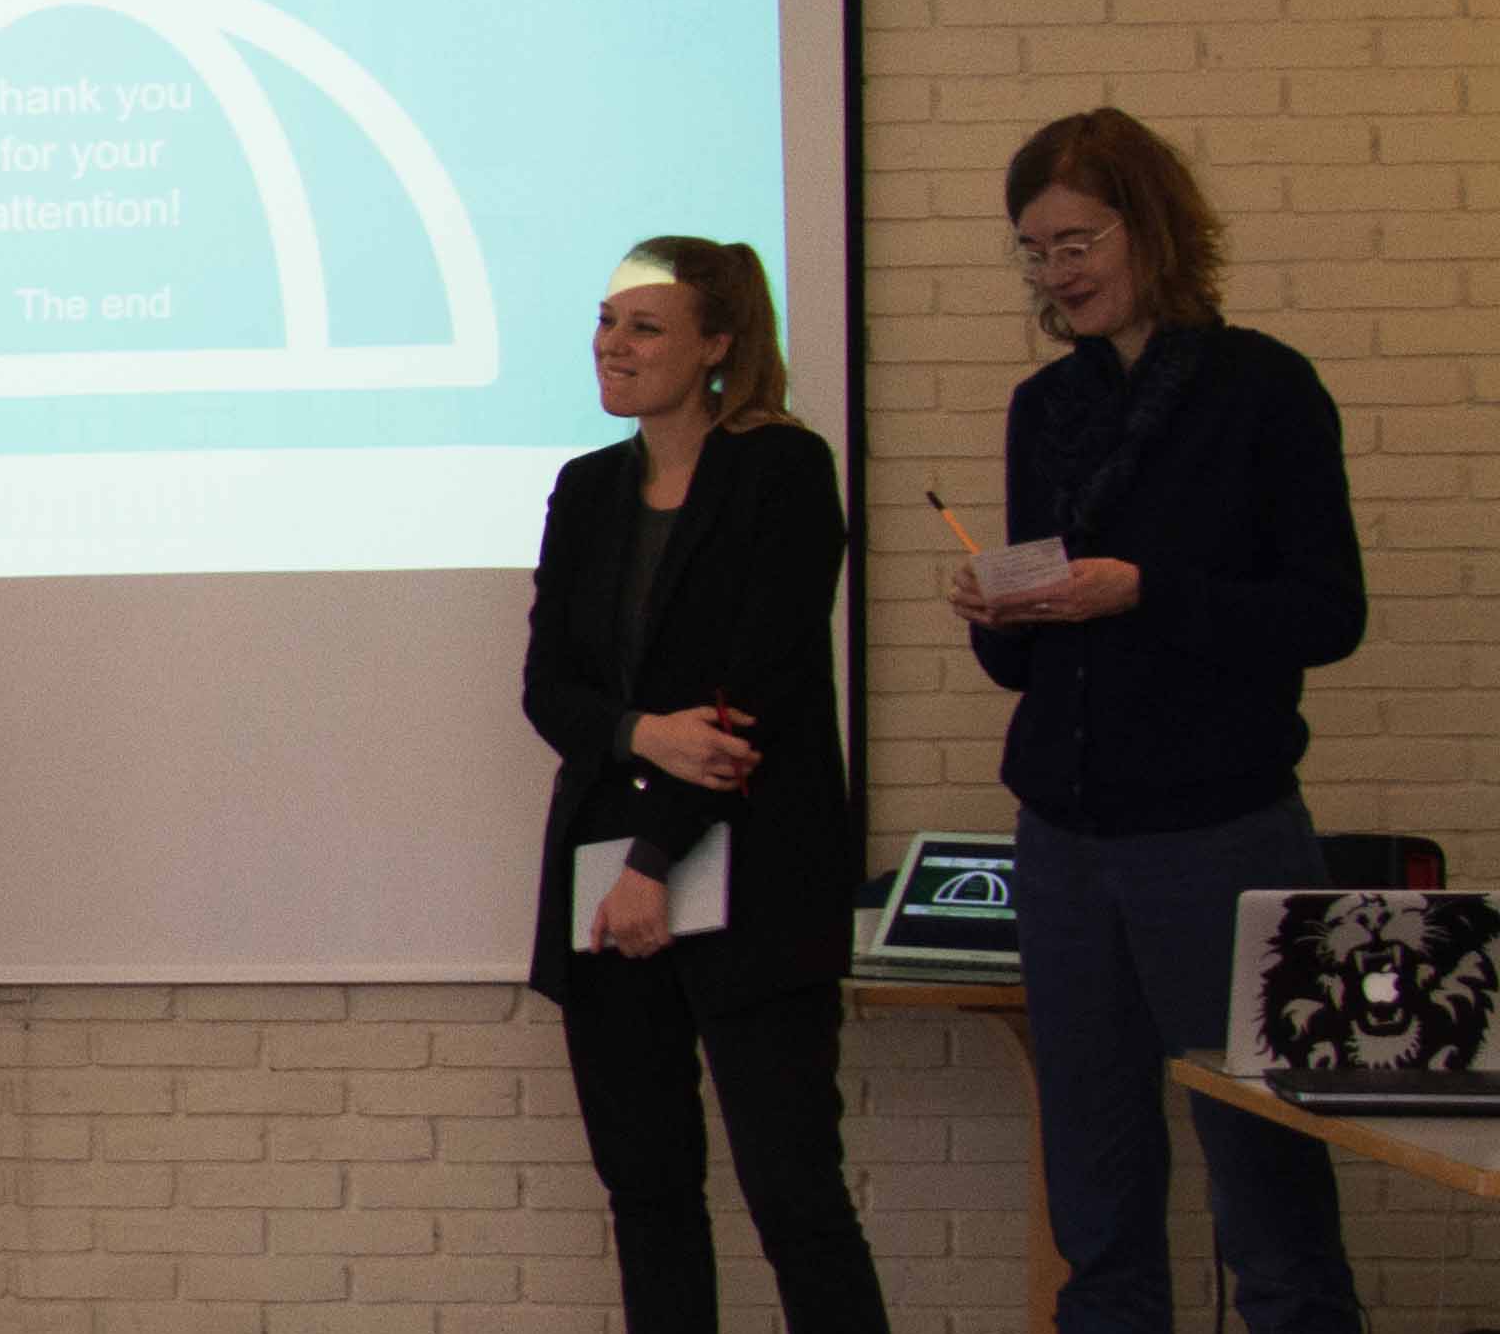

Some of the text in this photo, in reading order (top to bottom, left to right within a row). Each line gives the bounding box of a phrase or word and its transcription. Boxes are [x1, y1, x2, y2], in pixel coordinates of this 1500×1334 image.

[114, 81, 192, 122] you
[0, 133, 166, 180] for your
[13, 282, 172, 322] The end
